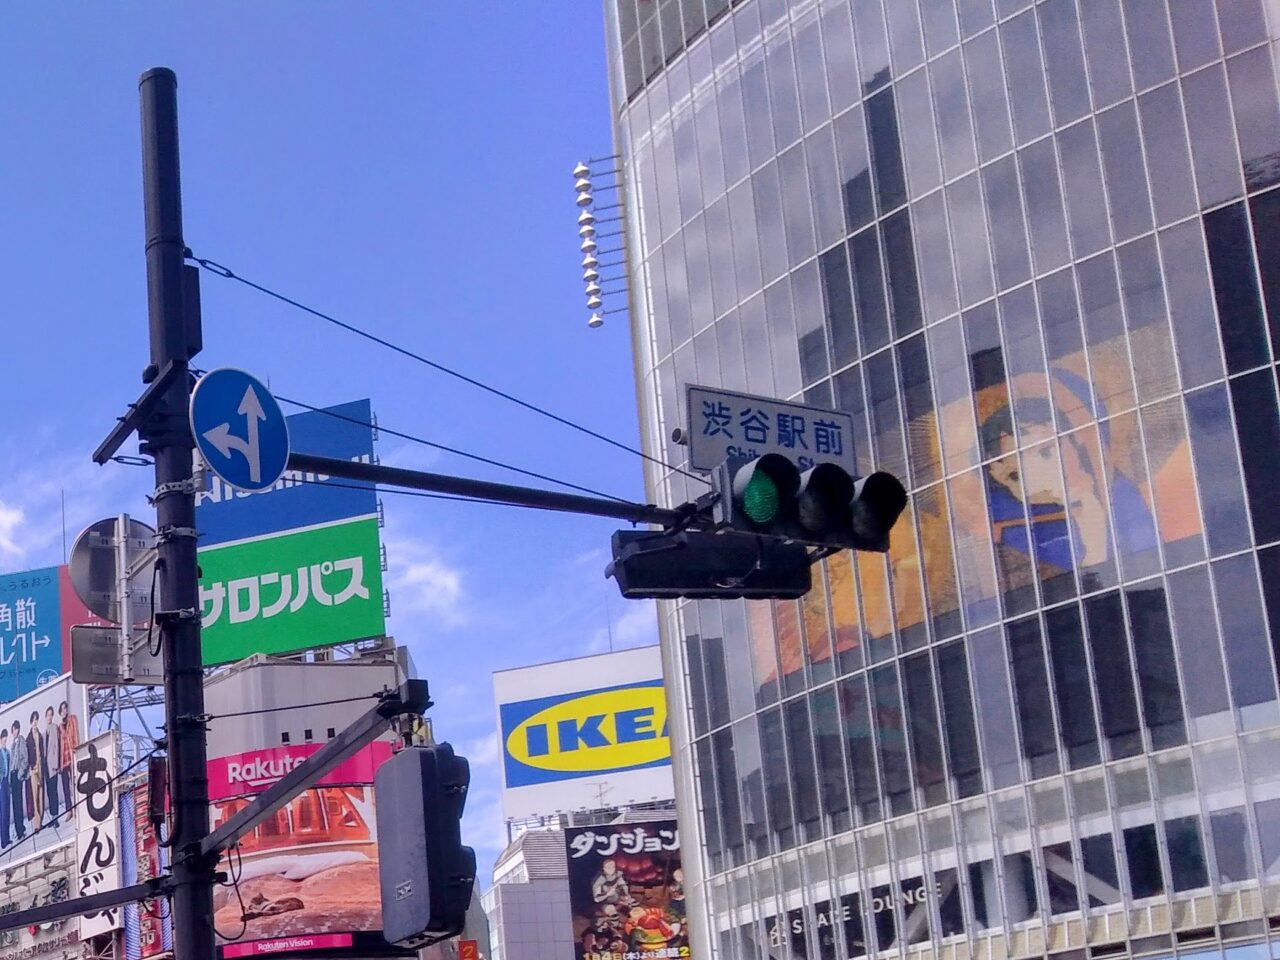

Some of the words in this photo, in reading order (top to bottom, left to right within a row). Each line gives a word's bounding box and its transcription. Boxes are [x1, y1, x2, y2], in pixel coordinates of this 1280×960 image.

[702, 399, 844, 457] 渋谷駅前
[199, 555, 370, 630] サロンパス
[526, 706, 669, 758] IKE
[227, 754, 308, 784] Rakute
[570, 827, 681, 859] ダンジョン
[863, 882, 943, 916] OUNGE
[257, 940, 289, 952] Rakuten
[289, 938, 314, 949] Vision
